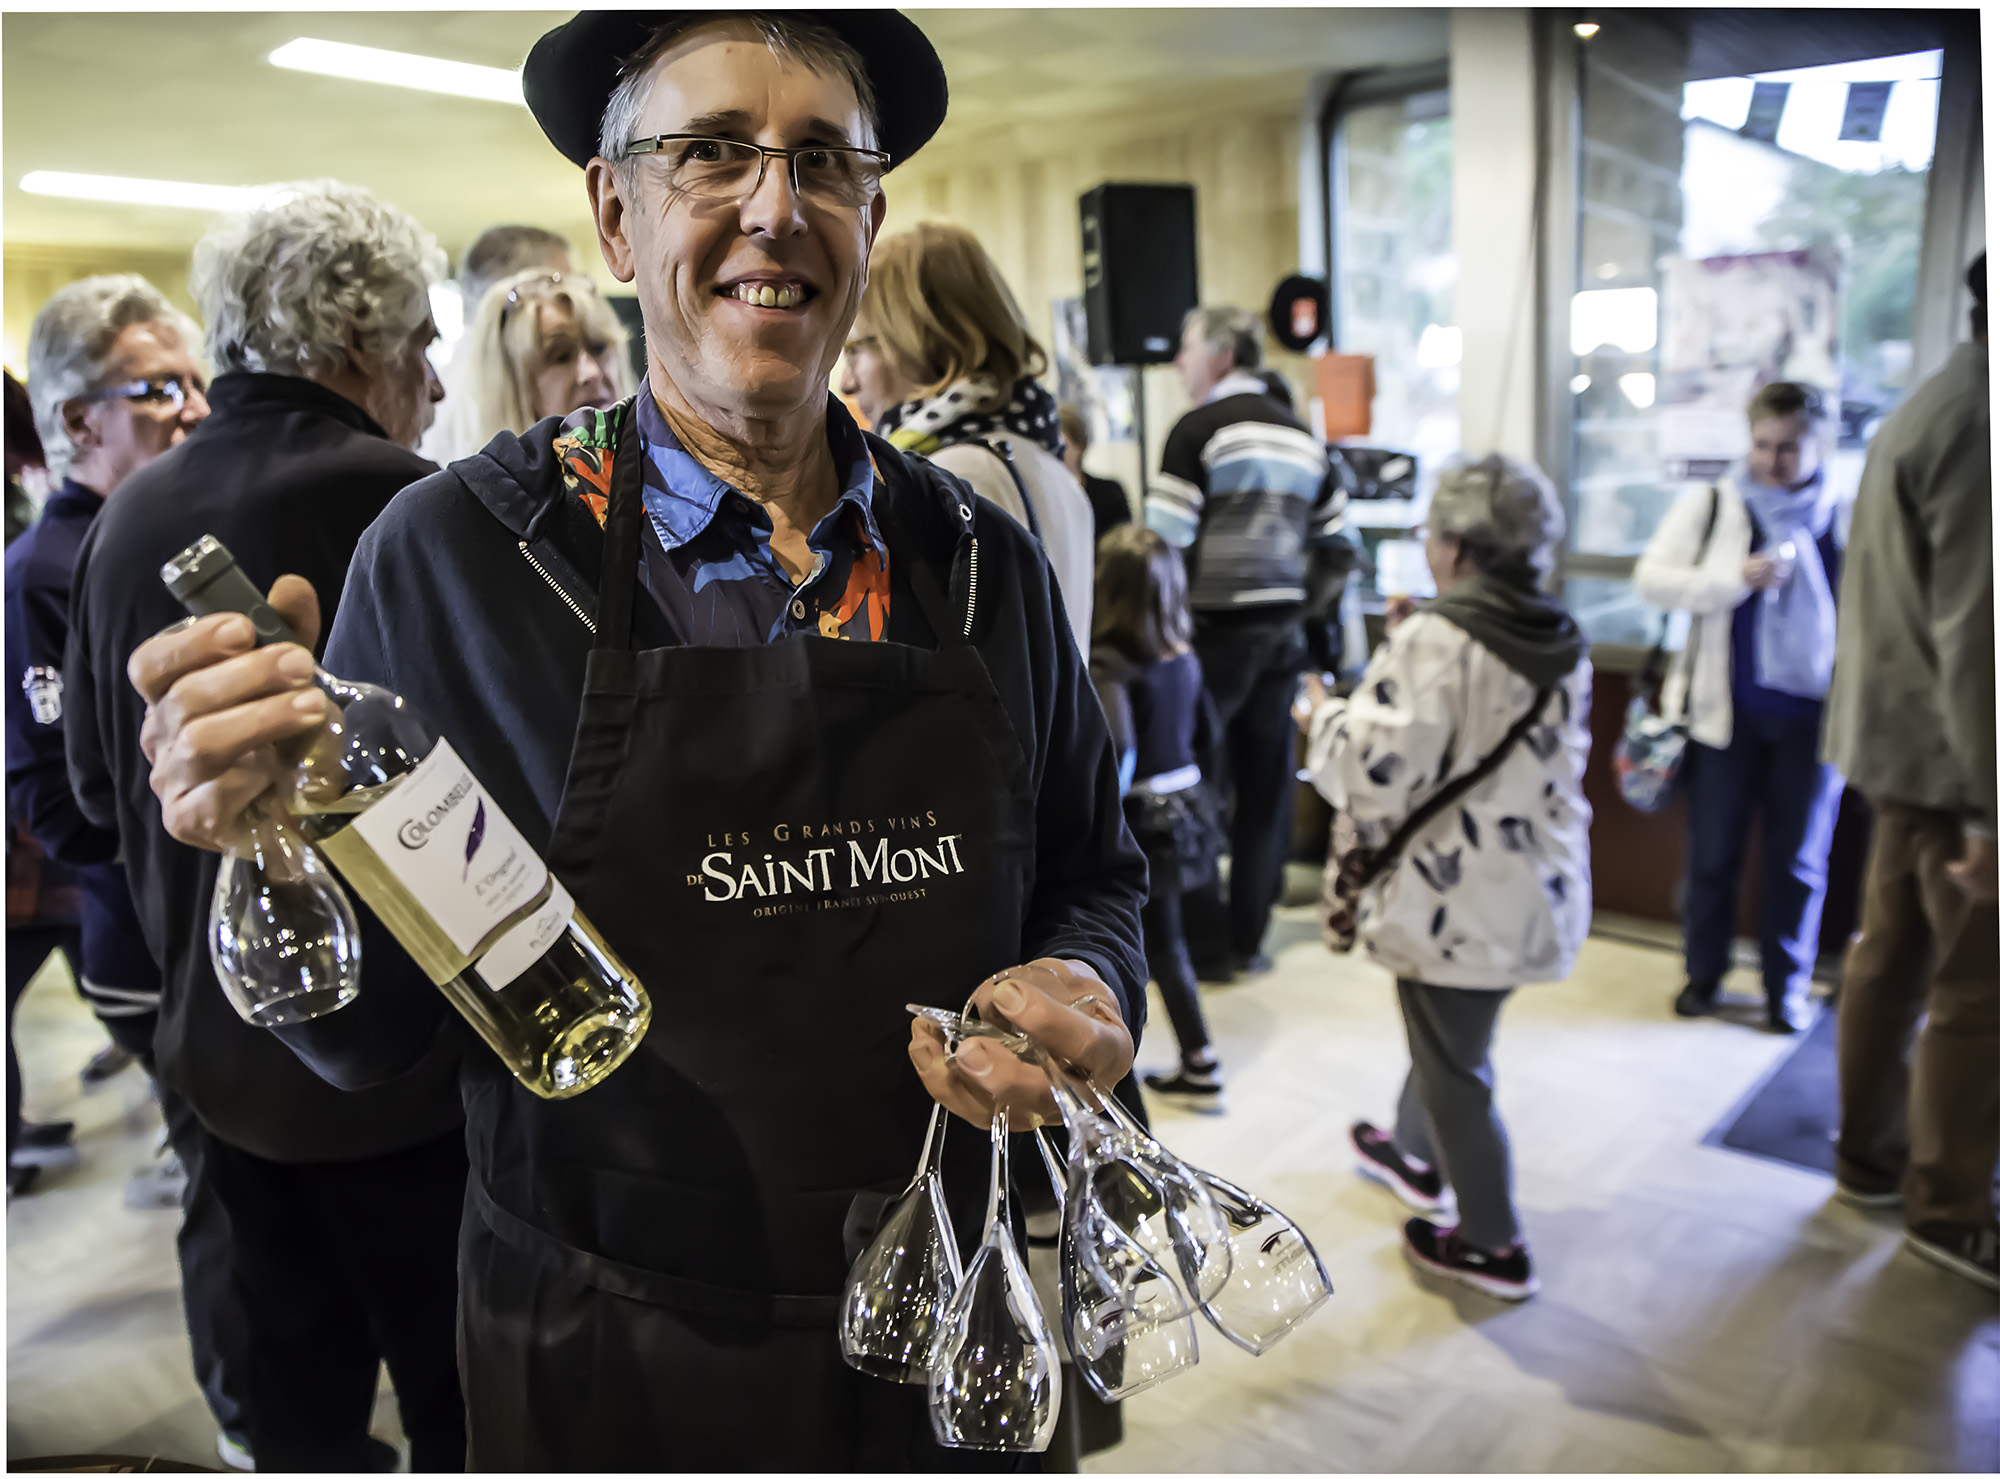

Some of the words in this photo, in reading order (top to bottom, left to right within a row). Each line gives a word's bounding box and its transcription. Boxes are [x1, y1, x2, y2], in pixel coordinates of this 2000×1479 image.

[708, 832, 750, 847] LES
[773, 819, 875, 842] GRANDS
[888, 810, 938, 830] VINS
[686, 873, 704, 886] DE
[847, 834, 965, 888] MONT
